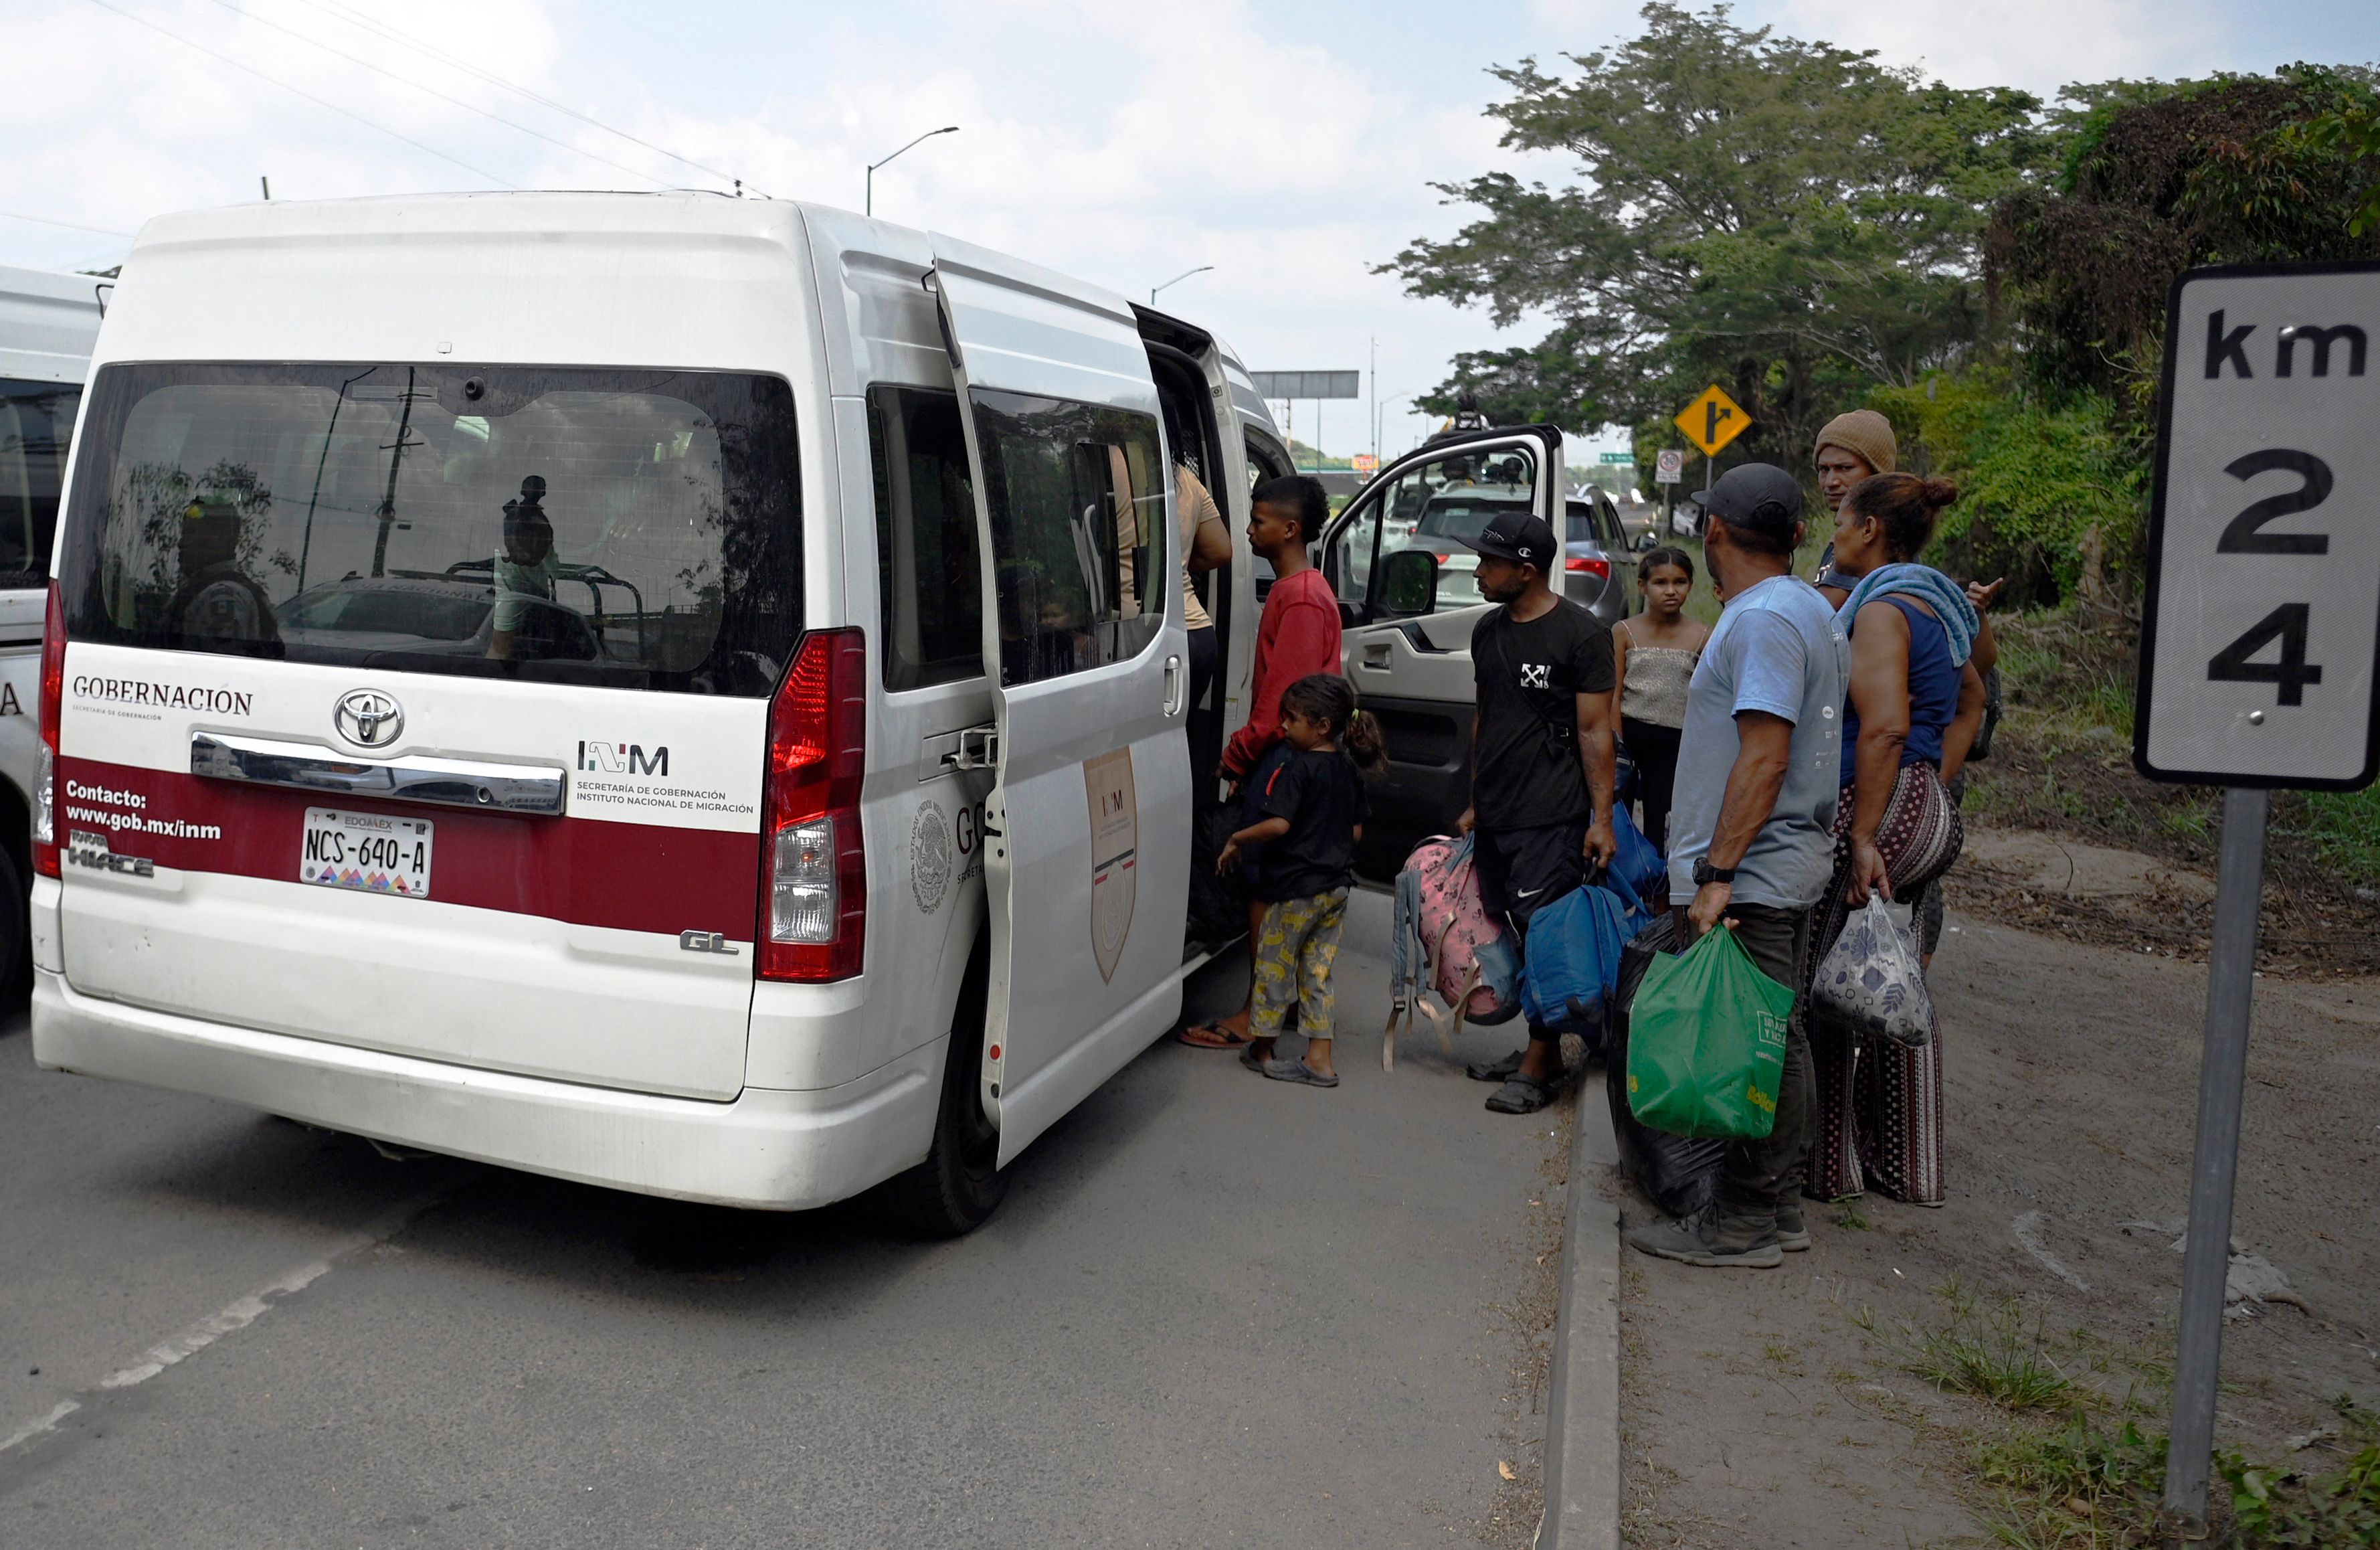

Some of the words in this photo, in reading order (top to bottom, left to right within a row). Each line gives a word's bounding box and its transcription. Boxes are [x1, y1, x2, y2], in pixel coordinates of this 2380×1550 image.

[2205, 309, 2367, 379] km
[2217, 448, 2334, 555] 2
[2207, 603, 2322, 707] 4
[73, 675, 254, 717] GOBERNACIÓN
[66, 779, 147, 809] Contacto:
[577, 781, 634, 794] SECRETARÍA
[637, 786, 650, 795] DE
[652, 787, 726, 800] GOBERNACIÓN
[577, 792, 625, 804] INSTITUTO
[627, 797, 677, 808] NACIONAL
[680, 800, 693, 809] DE
[696, 802, 753, 814] MIGRACIÓN
[66, 805, 222, 840] www.gob.mx/inm
[68, 846, 155, 879] HIACE
[306, 829, 424, 874] NCS-640-A
[680, 929, 739, 956] GL
